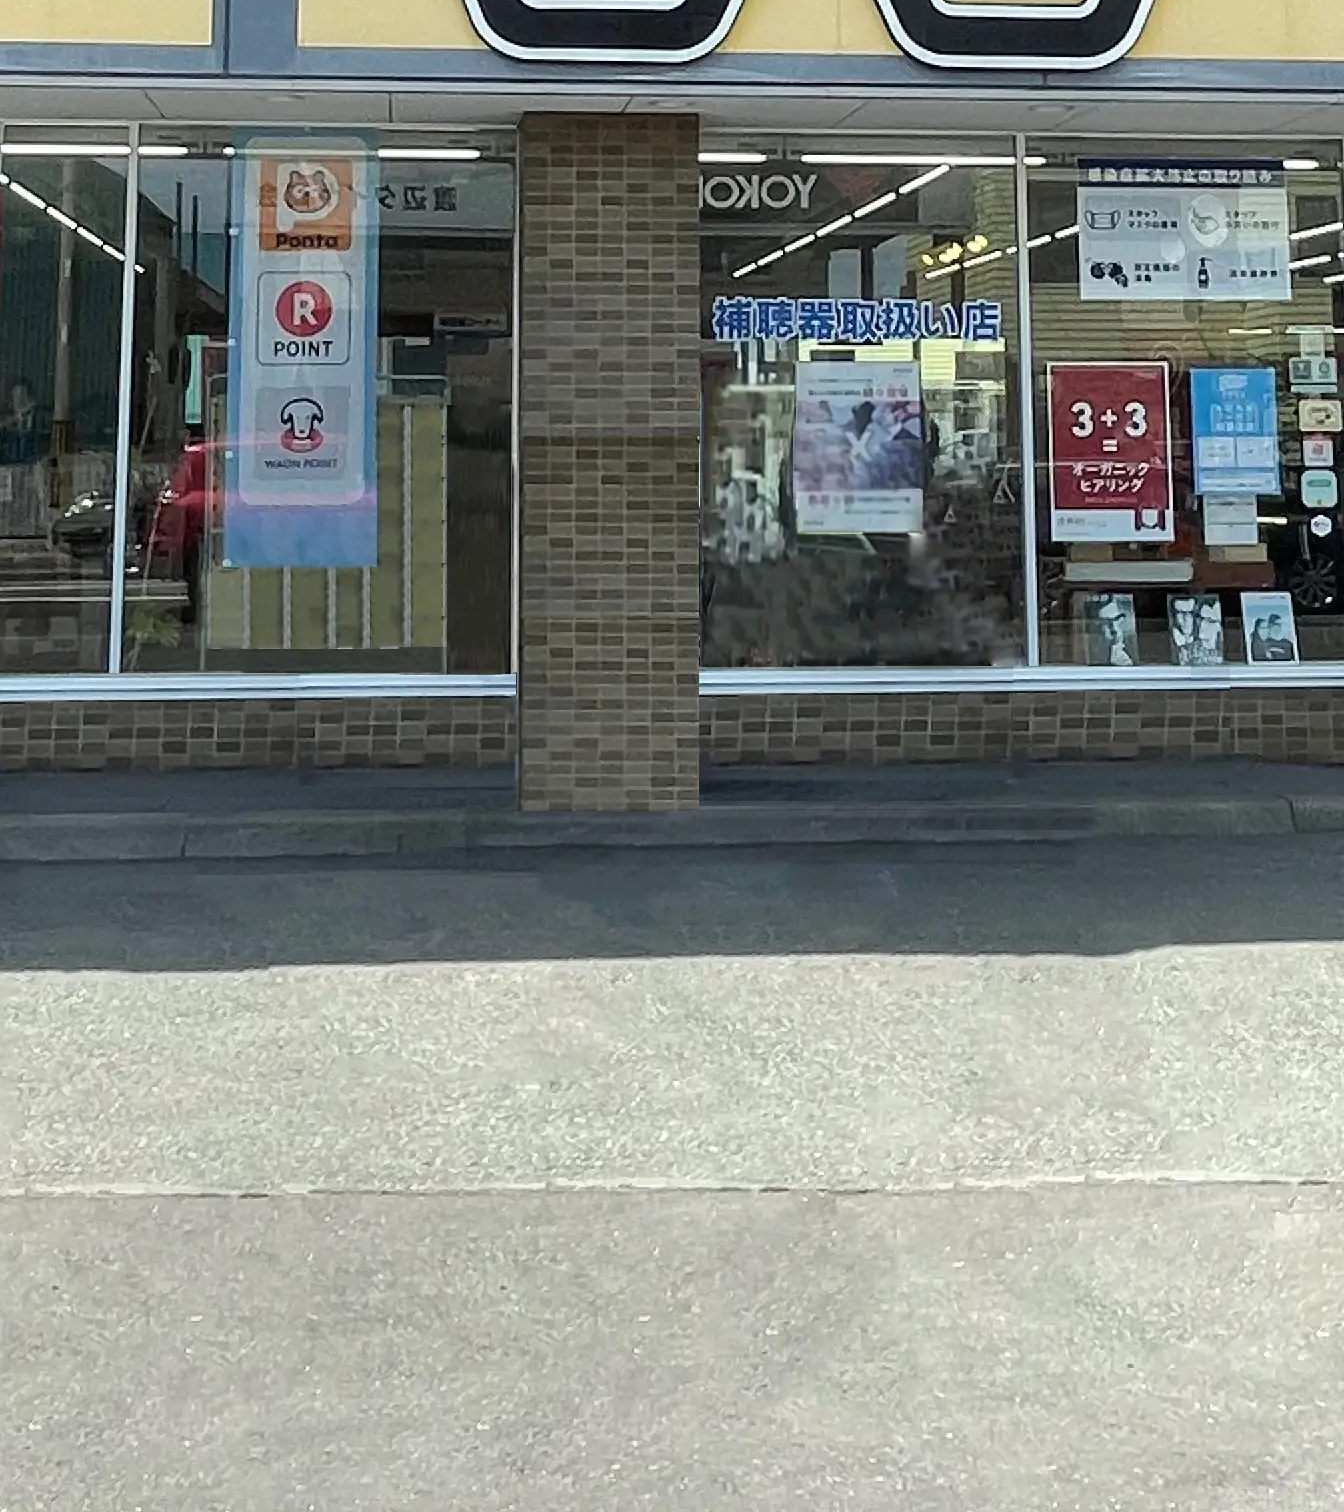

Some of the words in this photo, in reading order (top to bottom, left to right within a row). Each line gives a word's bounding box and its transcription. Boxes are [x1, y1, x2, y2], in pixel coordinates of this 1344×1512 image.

[275, 232, 338, 249] Ponta
[291, 291, 319, 327] R
[712, 295, 1003, 342] 補聴器取扱い店
[273, 340, 335, 358] POINT
[1072, 461, 1150, 476] オーガニック
[1080, 477, 1145, 494] ヒアリング
